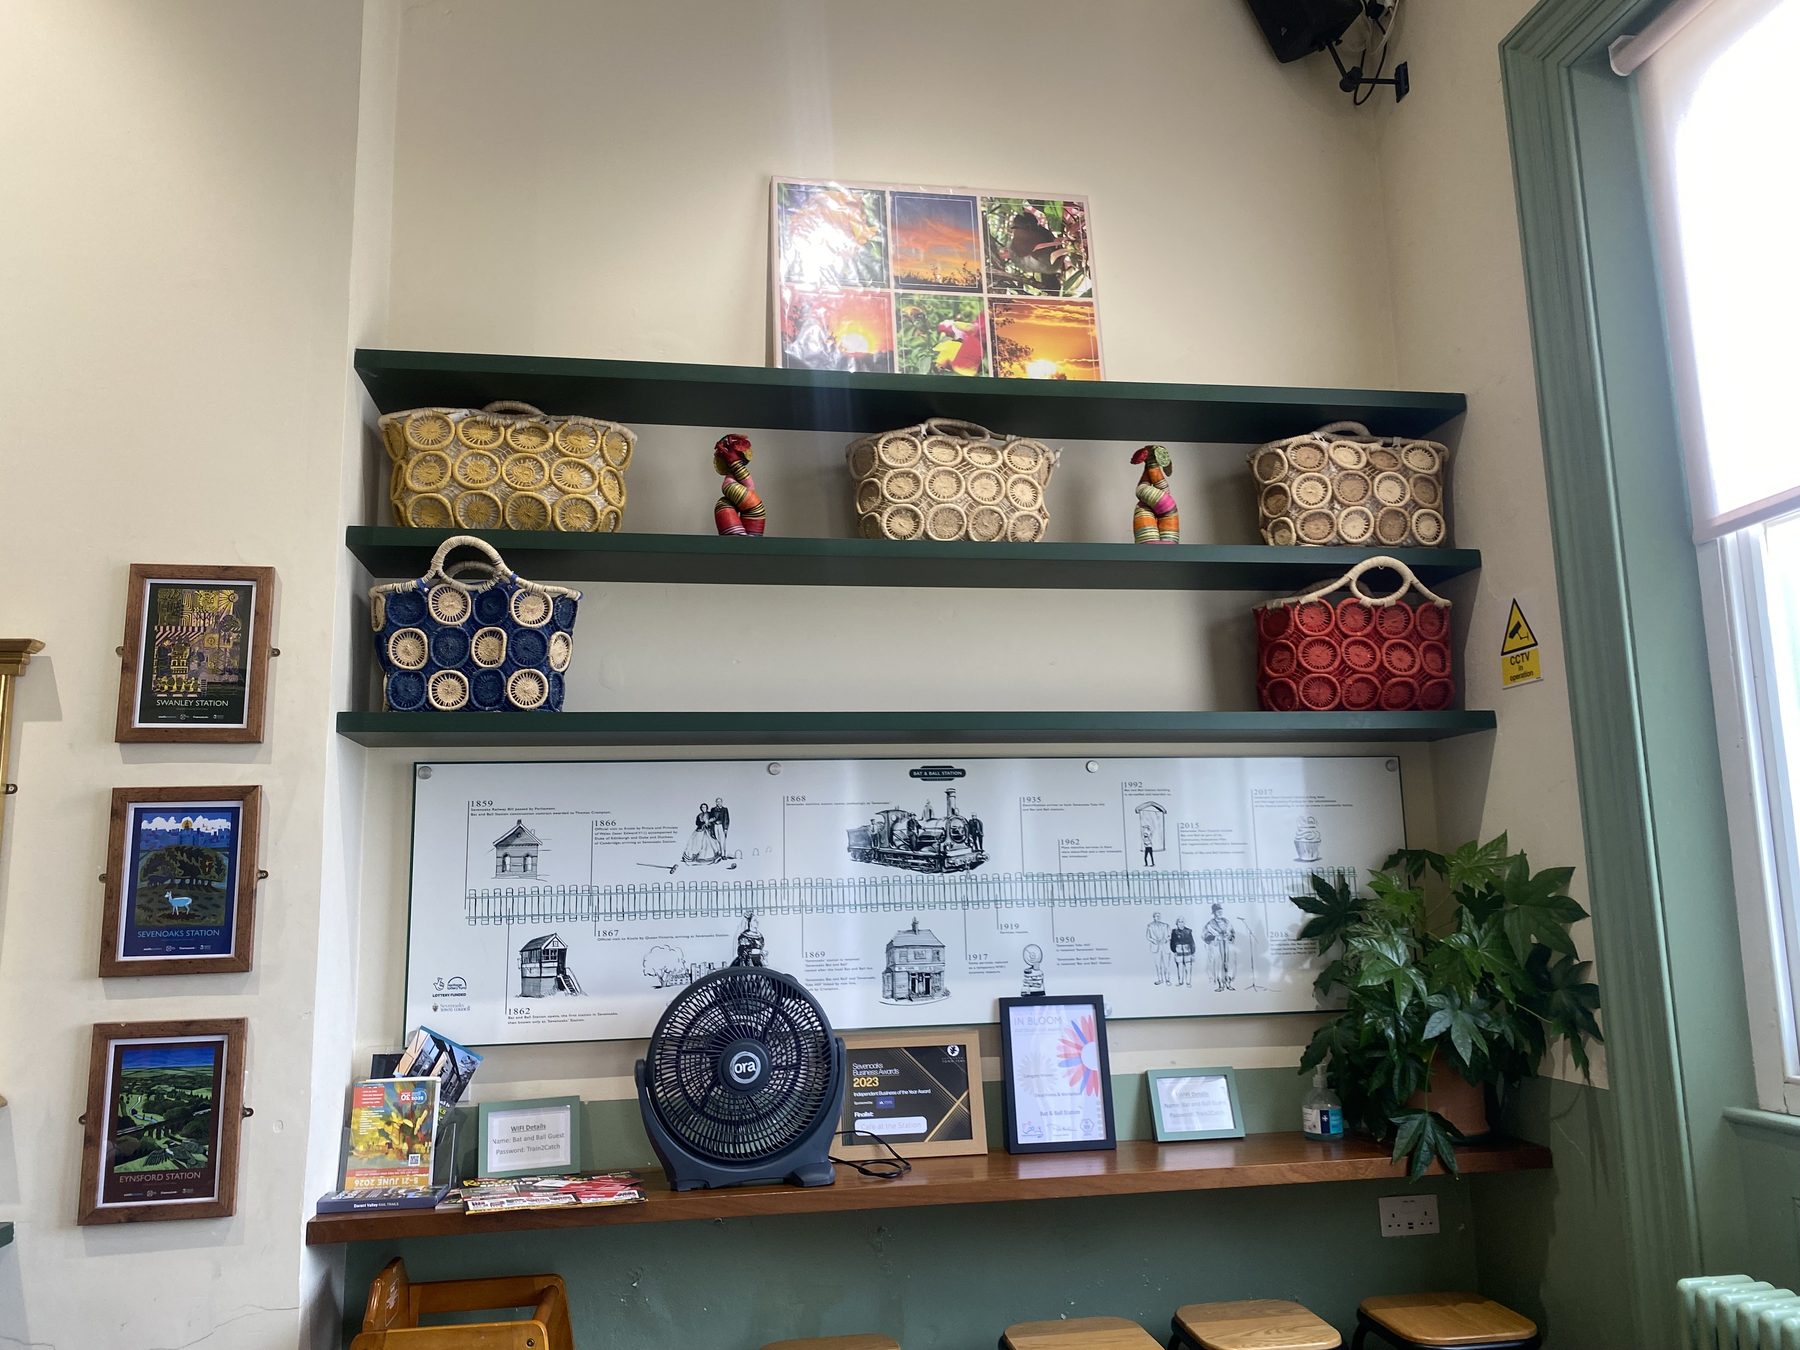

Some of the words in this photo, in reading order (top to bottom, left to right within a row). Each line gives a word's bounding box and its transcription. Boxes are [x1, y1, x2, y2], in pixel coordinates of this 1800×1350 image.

[1510, 651, 1530, 666] CCTV
[1510, 670, 1534, 682] operation
[156, 699, 193, 707] SWANLEY
[195, 699, 229, 707] STATION
[1061, 838, 1080, 846] 1962
[1000, 923, 1020, 931] 1919
[137, 929, 184, 938] SEVENOAKS
[186, 929, 220, 937] STATION
[597, 929, 619, 937] 1867
[1056, 936, 1076, 944] 1950
[805, 951, 826, 959] 1869
[968, 953, 988, 961] 1917
[508, 1007, 531, 1015] 1862
[1014, 1016, 1025, 1026] IN
[1027, 1015, 1063, 1026] BLOOM
[734, 1061, 756, 1074] ora
[852, 1062, 884, 1070] Sevenoaks
[852, 1069, 879, 1077] Business
[878, 1068, 900, 1076] Awards
[852, 1076, 880, 1088] 2023
[853, 1090, 879, 1098] Independent
[525, 1123, 547, 1131] Details
[495, 1147, 526, 1155] Password:
[526, 1144, 561, 1152] Train2Catch
[119, 1173, 164, 1183] EYNSFORD
[165, 1171, 201, 1181] STATION
[354, 1178, 376, 1187] 2026
[377, 1177, 401, 1186] JUNE
